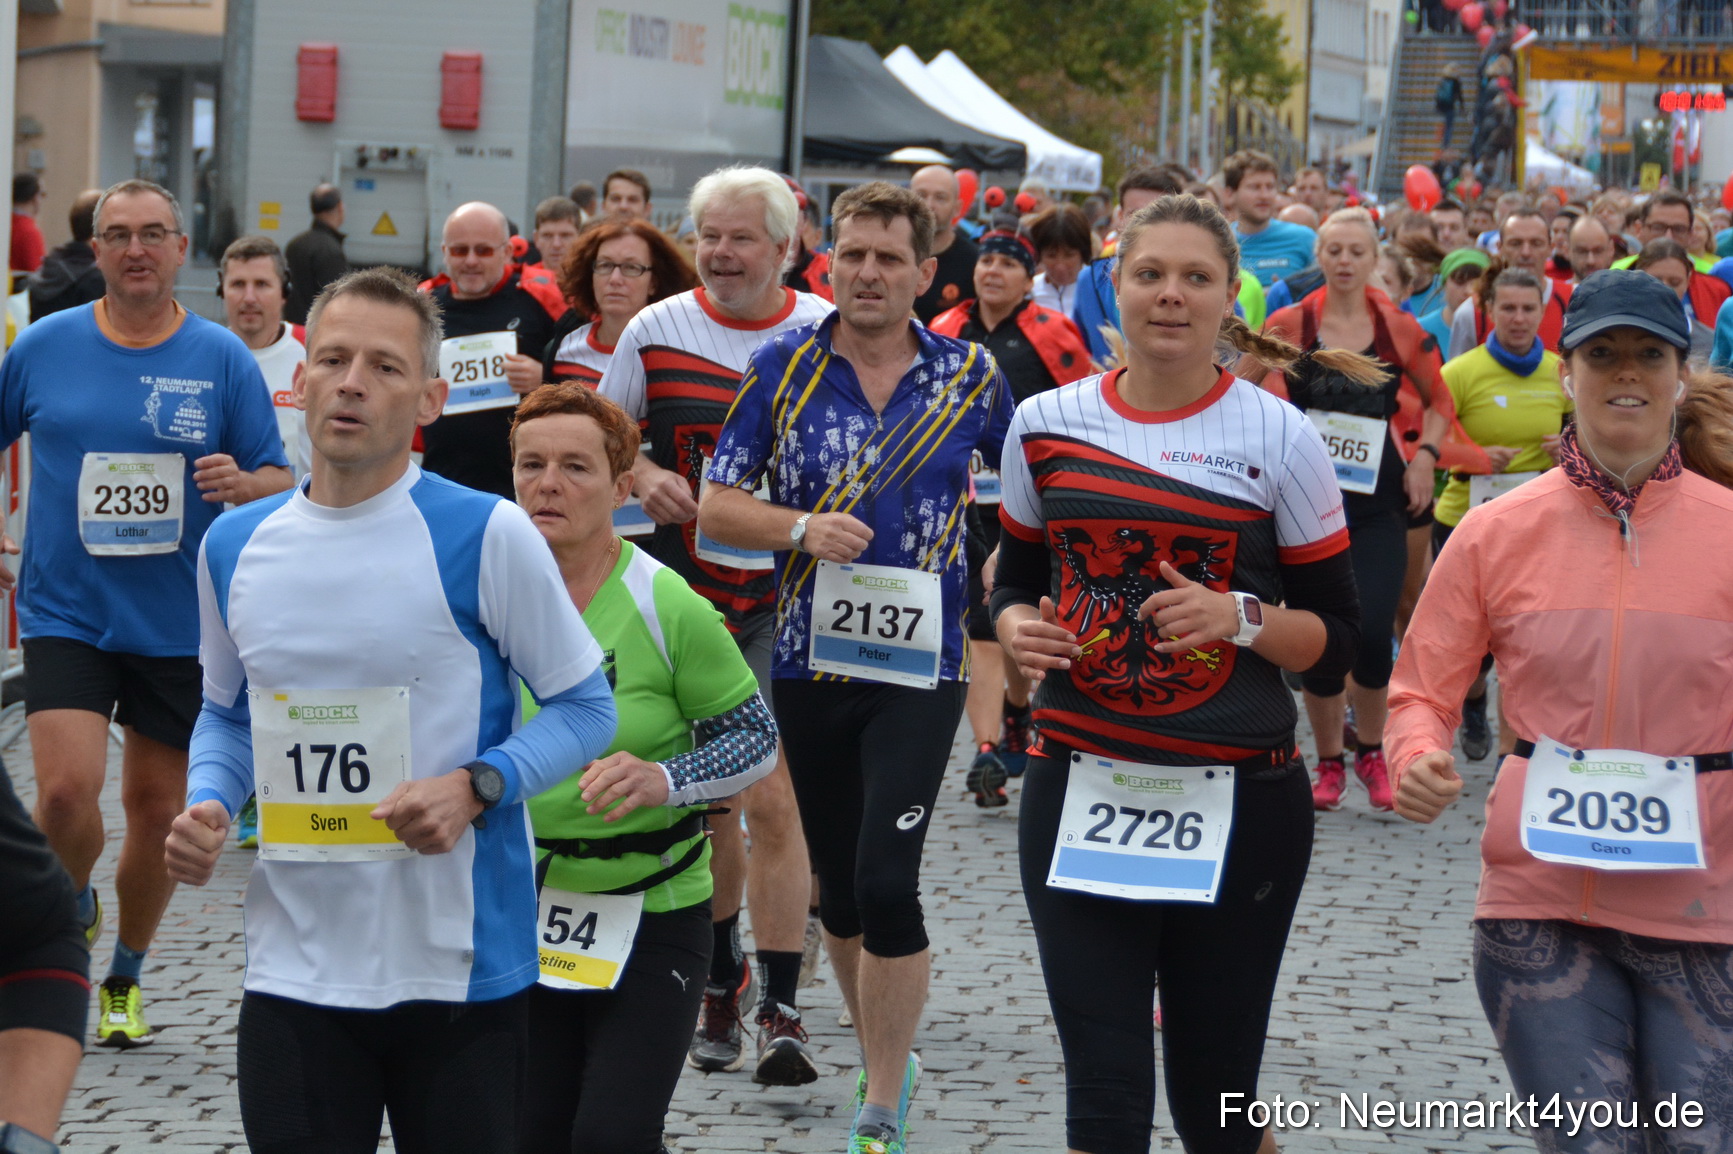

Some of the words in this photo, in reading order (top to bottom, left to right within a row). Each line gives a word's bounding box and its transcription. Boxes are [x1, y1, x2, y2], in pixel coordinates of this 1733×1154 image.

[1658, 53, 1733, 78] ZIEL
[451, 355, 506, 382] 2518
[140, 376, 154, 384] 12.
[156, 377, 214, 389] NEUMARKTER
[153, 384, 202, 395] STADTLAUF
[469, 387, 491, 397] Ralph
[1160, 451, 1245, 474] NEUMARKT
[94, 485, 169, 515] 2339
[115, 527, 149, 537] Lothar
[864, 576, 908, 590] BOCK
[830, 599, 924, 641] 2137
[858, 646, 892, 662] Peter
[302, 705, 358, 720] BOCK
[286, 743, 371, 794] 176
[1586, 762, 1647, 776] BOCK
[264, 785, 269, 795] D
[1128, 775, 1183, 791] BOCK
[1547, 788, 1671, 834] 2039
[311, 813, 348, 831] Sven
[1083, 803, 1204, 851] 2726
[1591, 841, 1632, 855] Caro
[543, 904, 598, 950] 54
